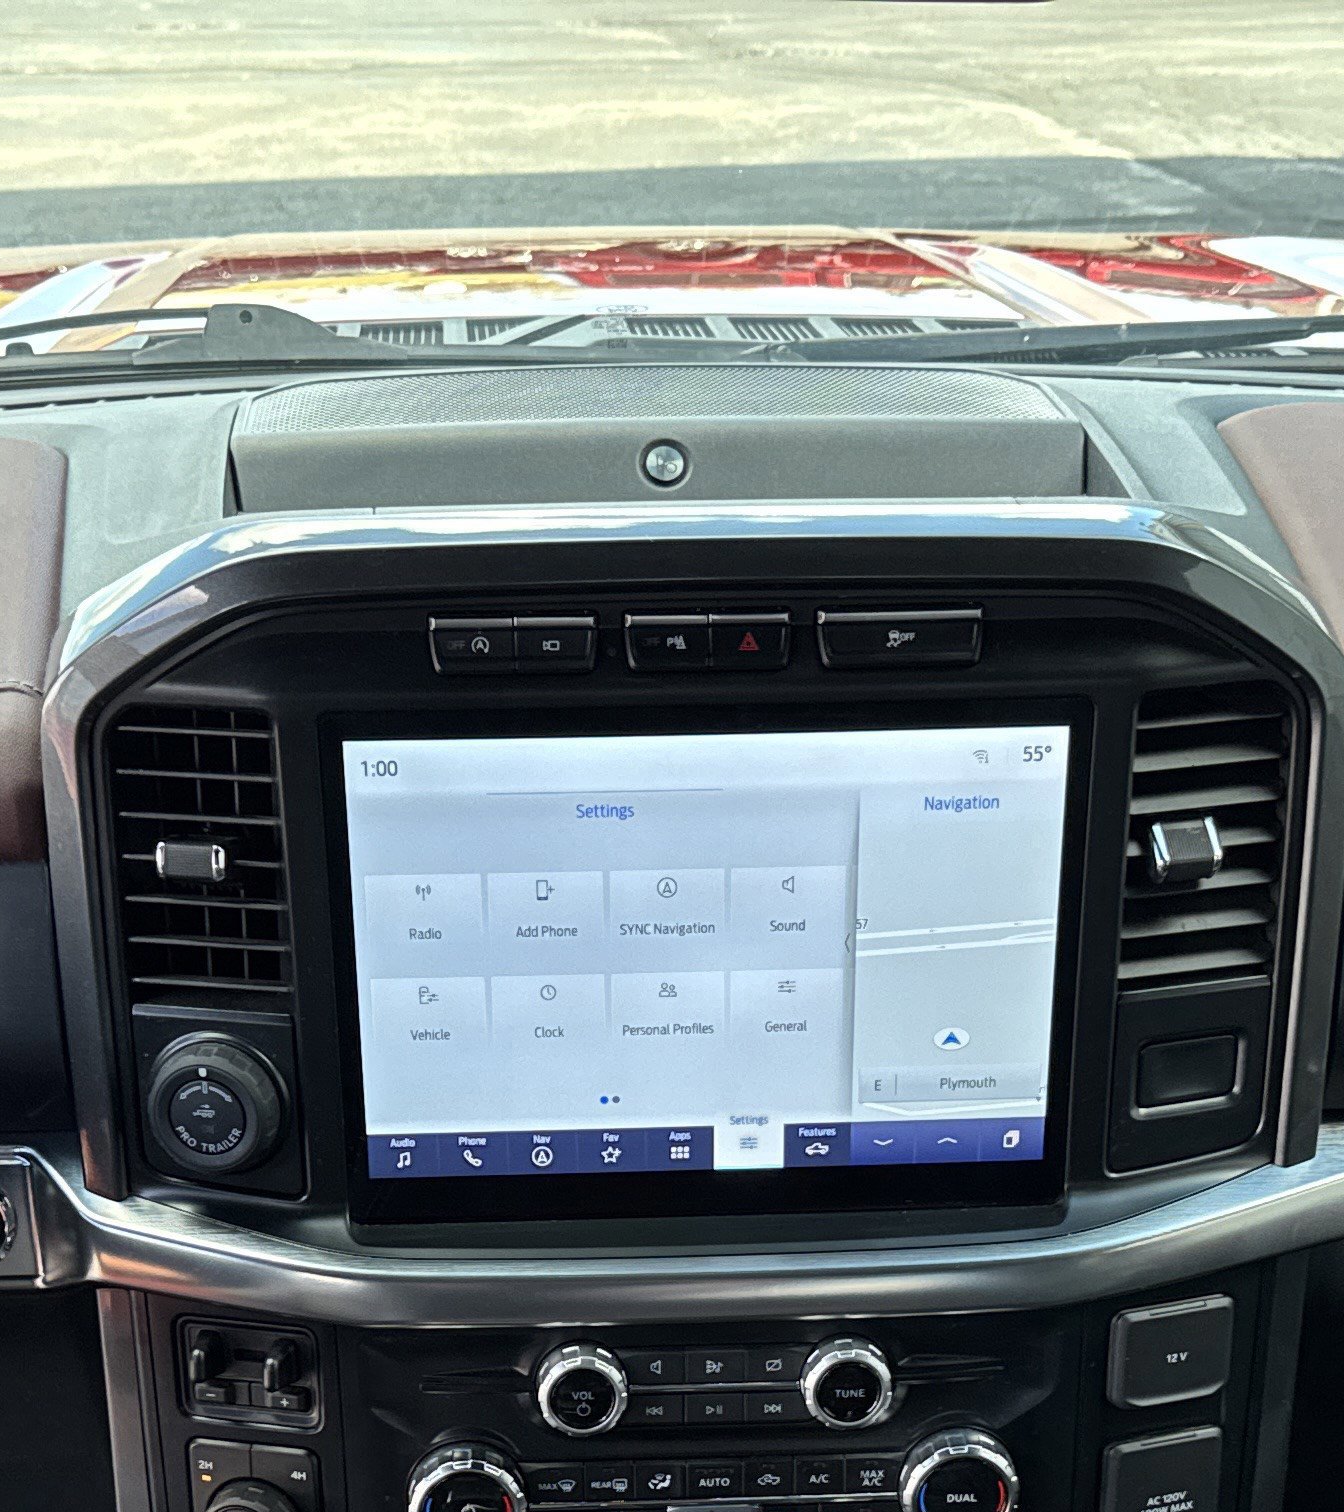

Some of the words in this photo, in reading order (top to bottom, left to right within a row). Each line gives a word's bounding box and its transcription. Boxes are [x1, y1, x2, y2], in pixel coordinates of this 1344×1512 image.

[360, 760, 398, 777] 1:00
[924, 795, 1000, 813] Navigation
[575, 803, 635, 821] Settings
[516, 926, 539, 938] Add
[541, 925, 578, 938] Phone
[619, 923, 651, 936] SYNC
[653, 921, 715, 936] Navigation
[769, 919, 806, 932] Sound
[408, 928, 443, 941] Radio
[534, 1025, 565, 1039] Clock
[622, 1023, 670, 1036] Personal
[673, 1022, 714, 1035] Profiles
[764, 1020, 807, 1033] General
[409, 1028, 451, 1041] Vehicle
[874, 1079, 882, 1092] E
[939, 1075, 997, 1091] Plymouth
[729, 1115, 768, 1127] Settings
[602, 1132, 620, 1143] Fav
[668, 1130, 691, 1142] Apps
[798, 1127, 836, 1138] Features
[175, 1125, 198, 1147] PRO
[201, 1127, 243, 1153] TRAILER
[389, 1137, 416, 1149] Audio
[458, 1135, 486, 1147] Phone
[532, 1134, 551, 1145] Nav
[571, 1391, 595, 1400] VOL
[834, 1388, 866, 1399] TUNE
[198, 1459, 213, 1471] 2H
[290, 1470, 307, 1481] 4H
[809, 1473, 830, 1484] A/C
[859, 1469, 886, 1479] MAX
[590, 1481, 612, 1489] REAR
[698, 1477, 731, 1488] AUTO
[861, 1476, 883, 1487] A/C
[946, 1493, 978, 1503] DUAL
[1146, 1495, 1161, 1507] AC
[1162, 1490, 1187, 1503] 120V
[1169, 1500, 1194, 1512] MAX
